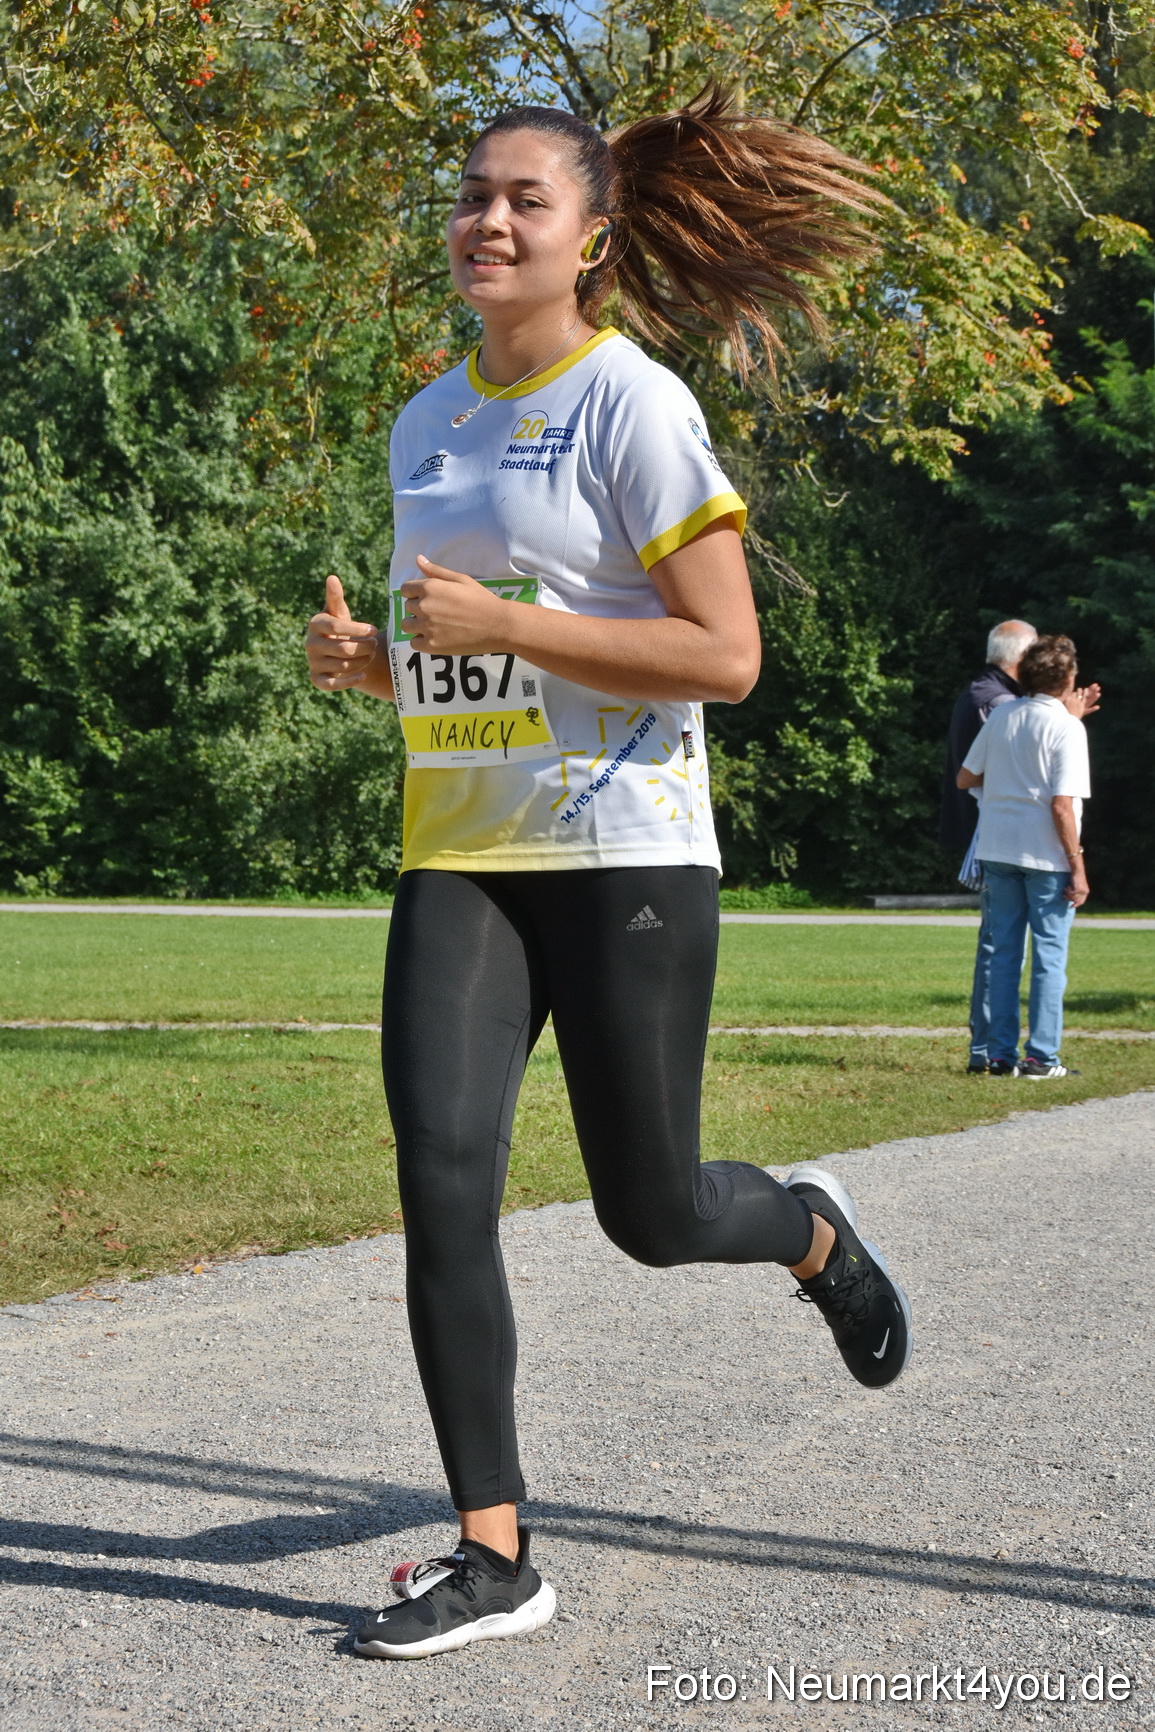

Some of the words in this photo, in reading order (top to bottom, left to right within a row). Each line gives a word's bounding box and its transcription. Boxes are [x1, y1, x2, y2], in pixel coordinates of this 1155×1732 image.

[513, 418, 546, 440] 20
[544, 429, 574, 439] JAHRE
[498, 459, 557, 475] Stadtlauf
[406, 652, 515, 704] 1367
[430, 717, 515, 759] NANCY
[560, 792, 593, 824] 14./15.
[589, 737, 639, 793] September
[635, 713, 657, 739] 2019
[626, 920, 663, 931] adidas
